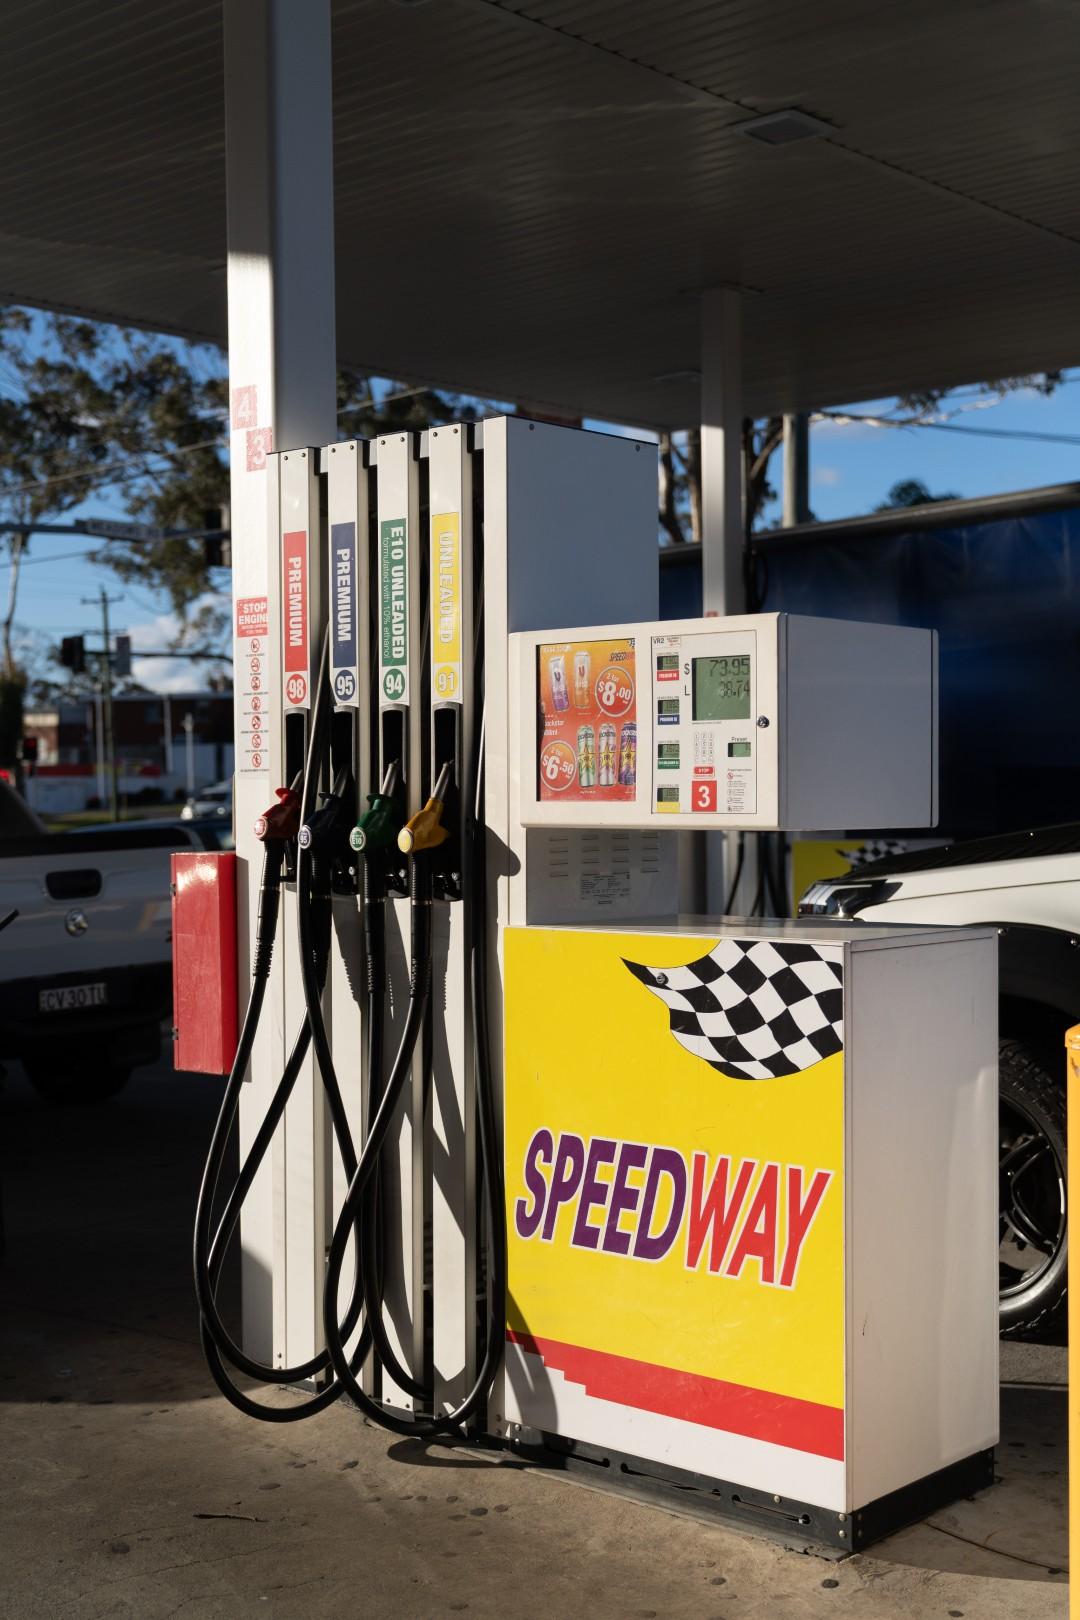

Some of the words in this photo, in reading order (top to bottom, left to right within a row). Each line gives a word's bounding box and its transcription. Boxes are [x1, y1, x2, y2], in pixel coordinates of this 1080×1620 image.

[237, 393, 251, 418] 4
[252, 434, 267, 465] 3
[391, 526, 404, 560] E10
[383, 537, 391, 583] formulated
[337, 549, 352, 642] PREMIUM
[383, 584, 391, 599] with
[439, 531, 455, 643] UNLEADED
[243, 602, 267, 614] STOP
[288, 556, 303, 646] PREMIUM
[391, 565, 405, 659] UNLEADED
[383, 627, 391, 659] ethanol
[709, 658, 750, 677] 73.95
[288, 679, 304, 699] 98
[337, 676, 354, 696] 95
[385, 674, 402, 694] 94
[438, 672, 455, 692] 91
[598, 680, 632, 706] $8.00
[684, 685, 690, 696] L
[697, 785, 711, 808] 3
[515, 1128, 834, 1290] SPEEDWAY
